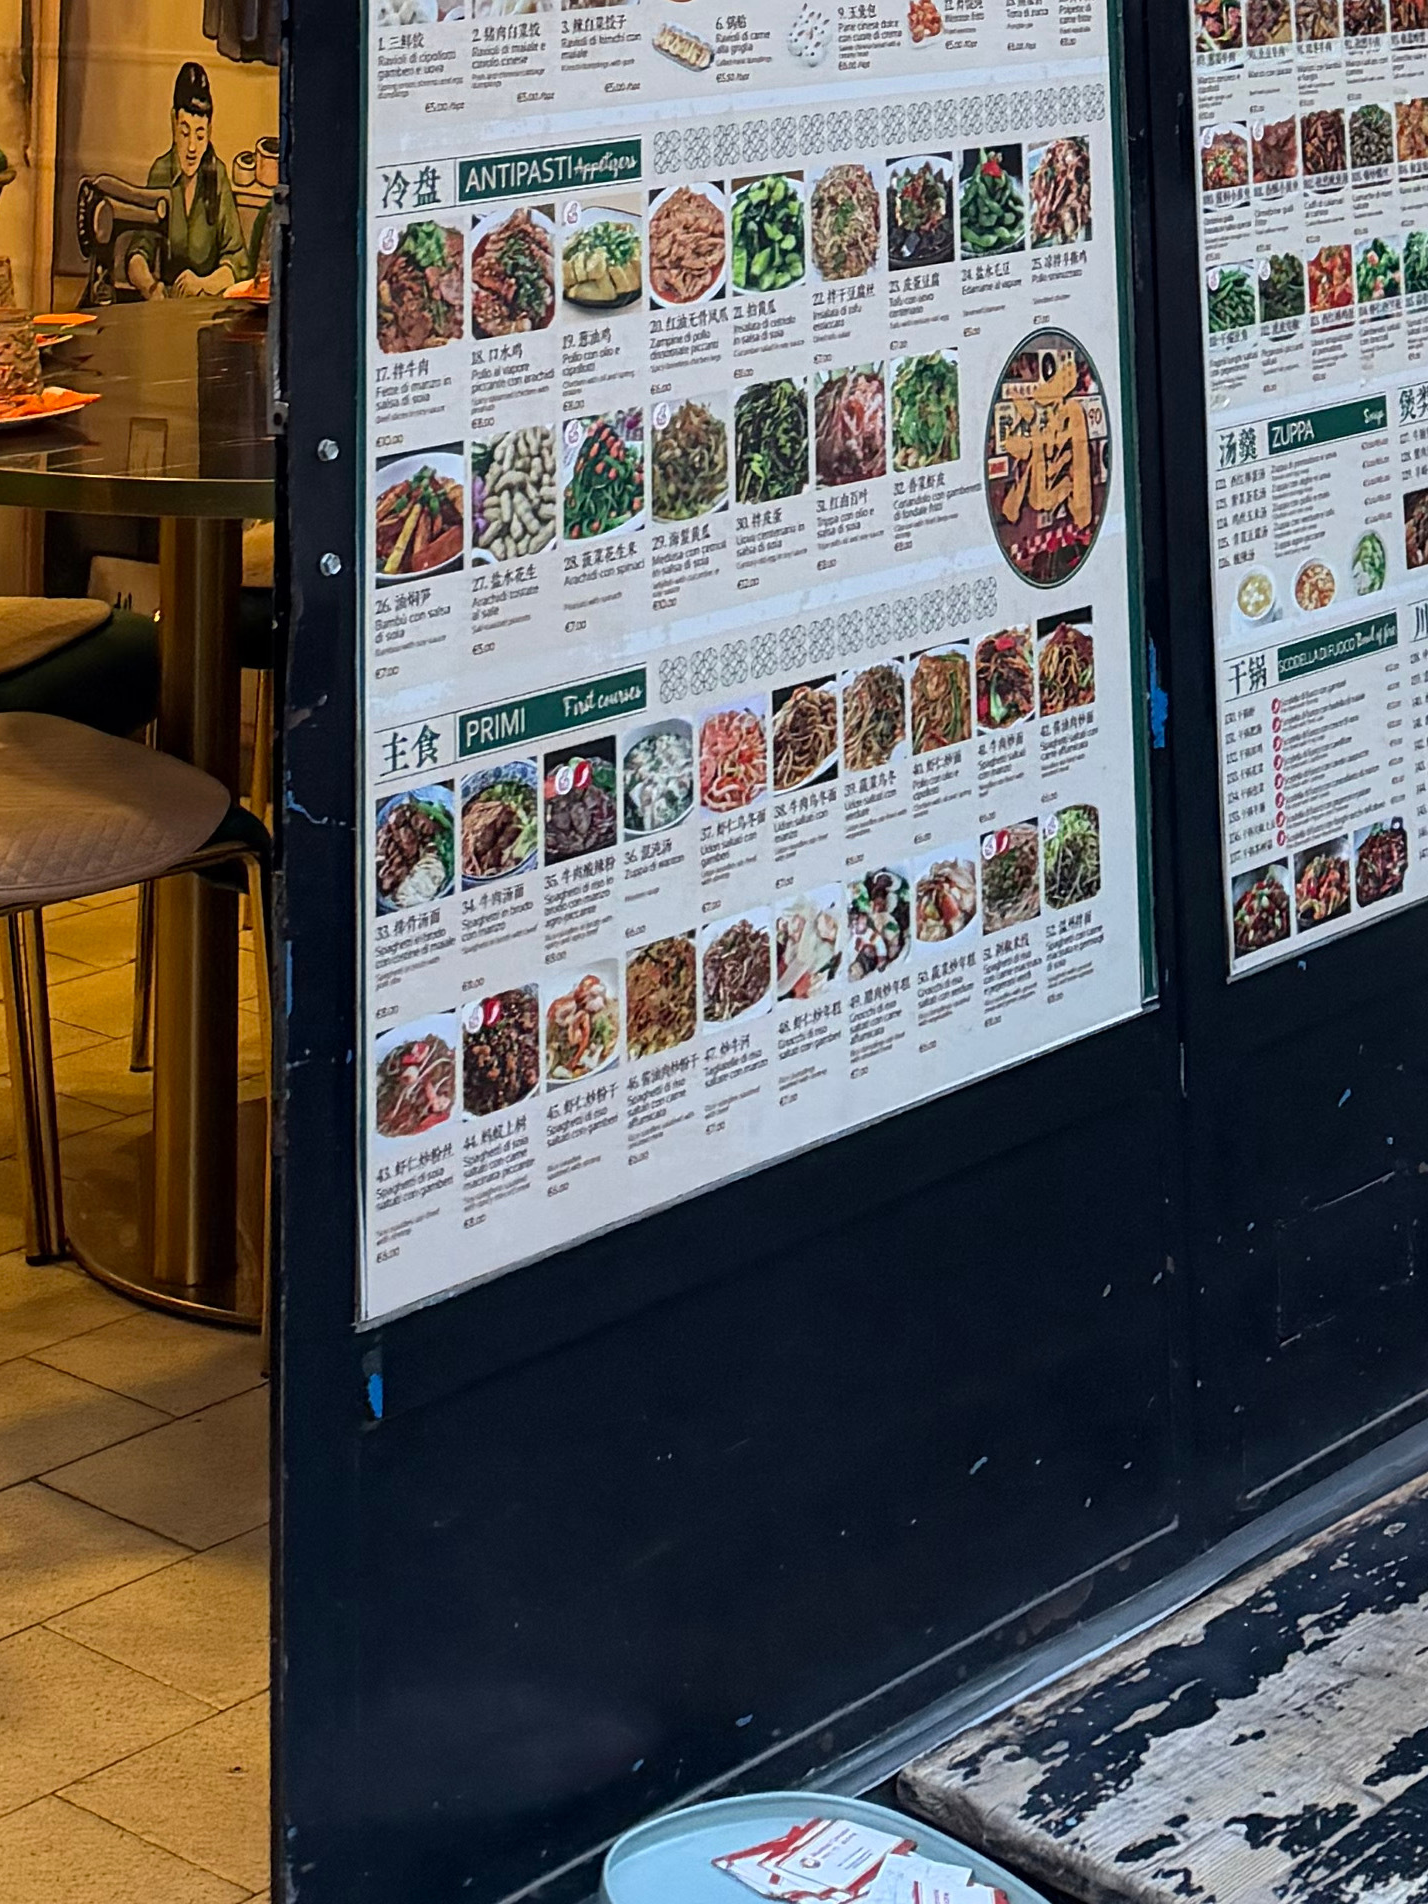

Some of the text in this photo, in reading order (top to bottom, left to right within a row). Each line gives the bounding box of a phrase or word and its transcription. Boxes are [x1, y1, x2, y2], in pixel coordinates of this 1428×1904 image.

[381, 165, 441, 209] 冷盘
[465, 155, 572, 193] ANTIPASTI
[1219, 427, 1258, 467] 汤羹
[1271, 420, 1315, 447] ZUPPA
[1228, 654, 1267, 696] 干锅
[465, 708, 525, 748] PRIMI
[380, 723, 441, 777] 主食
